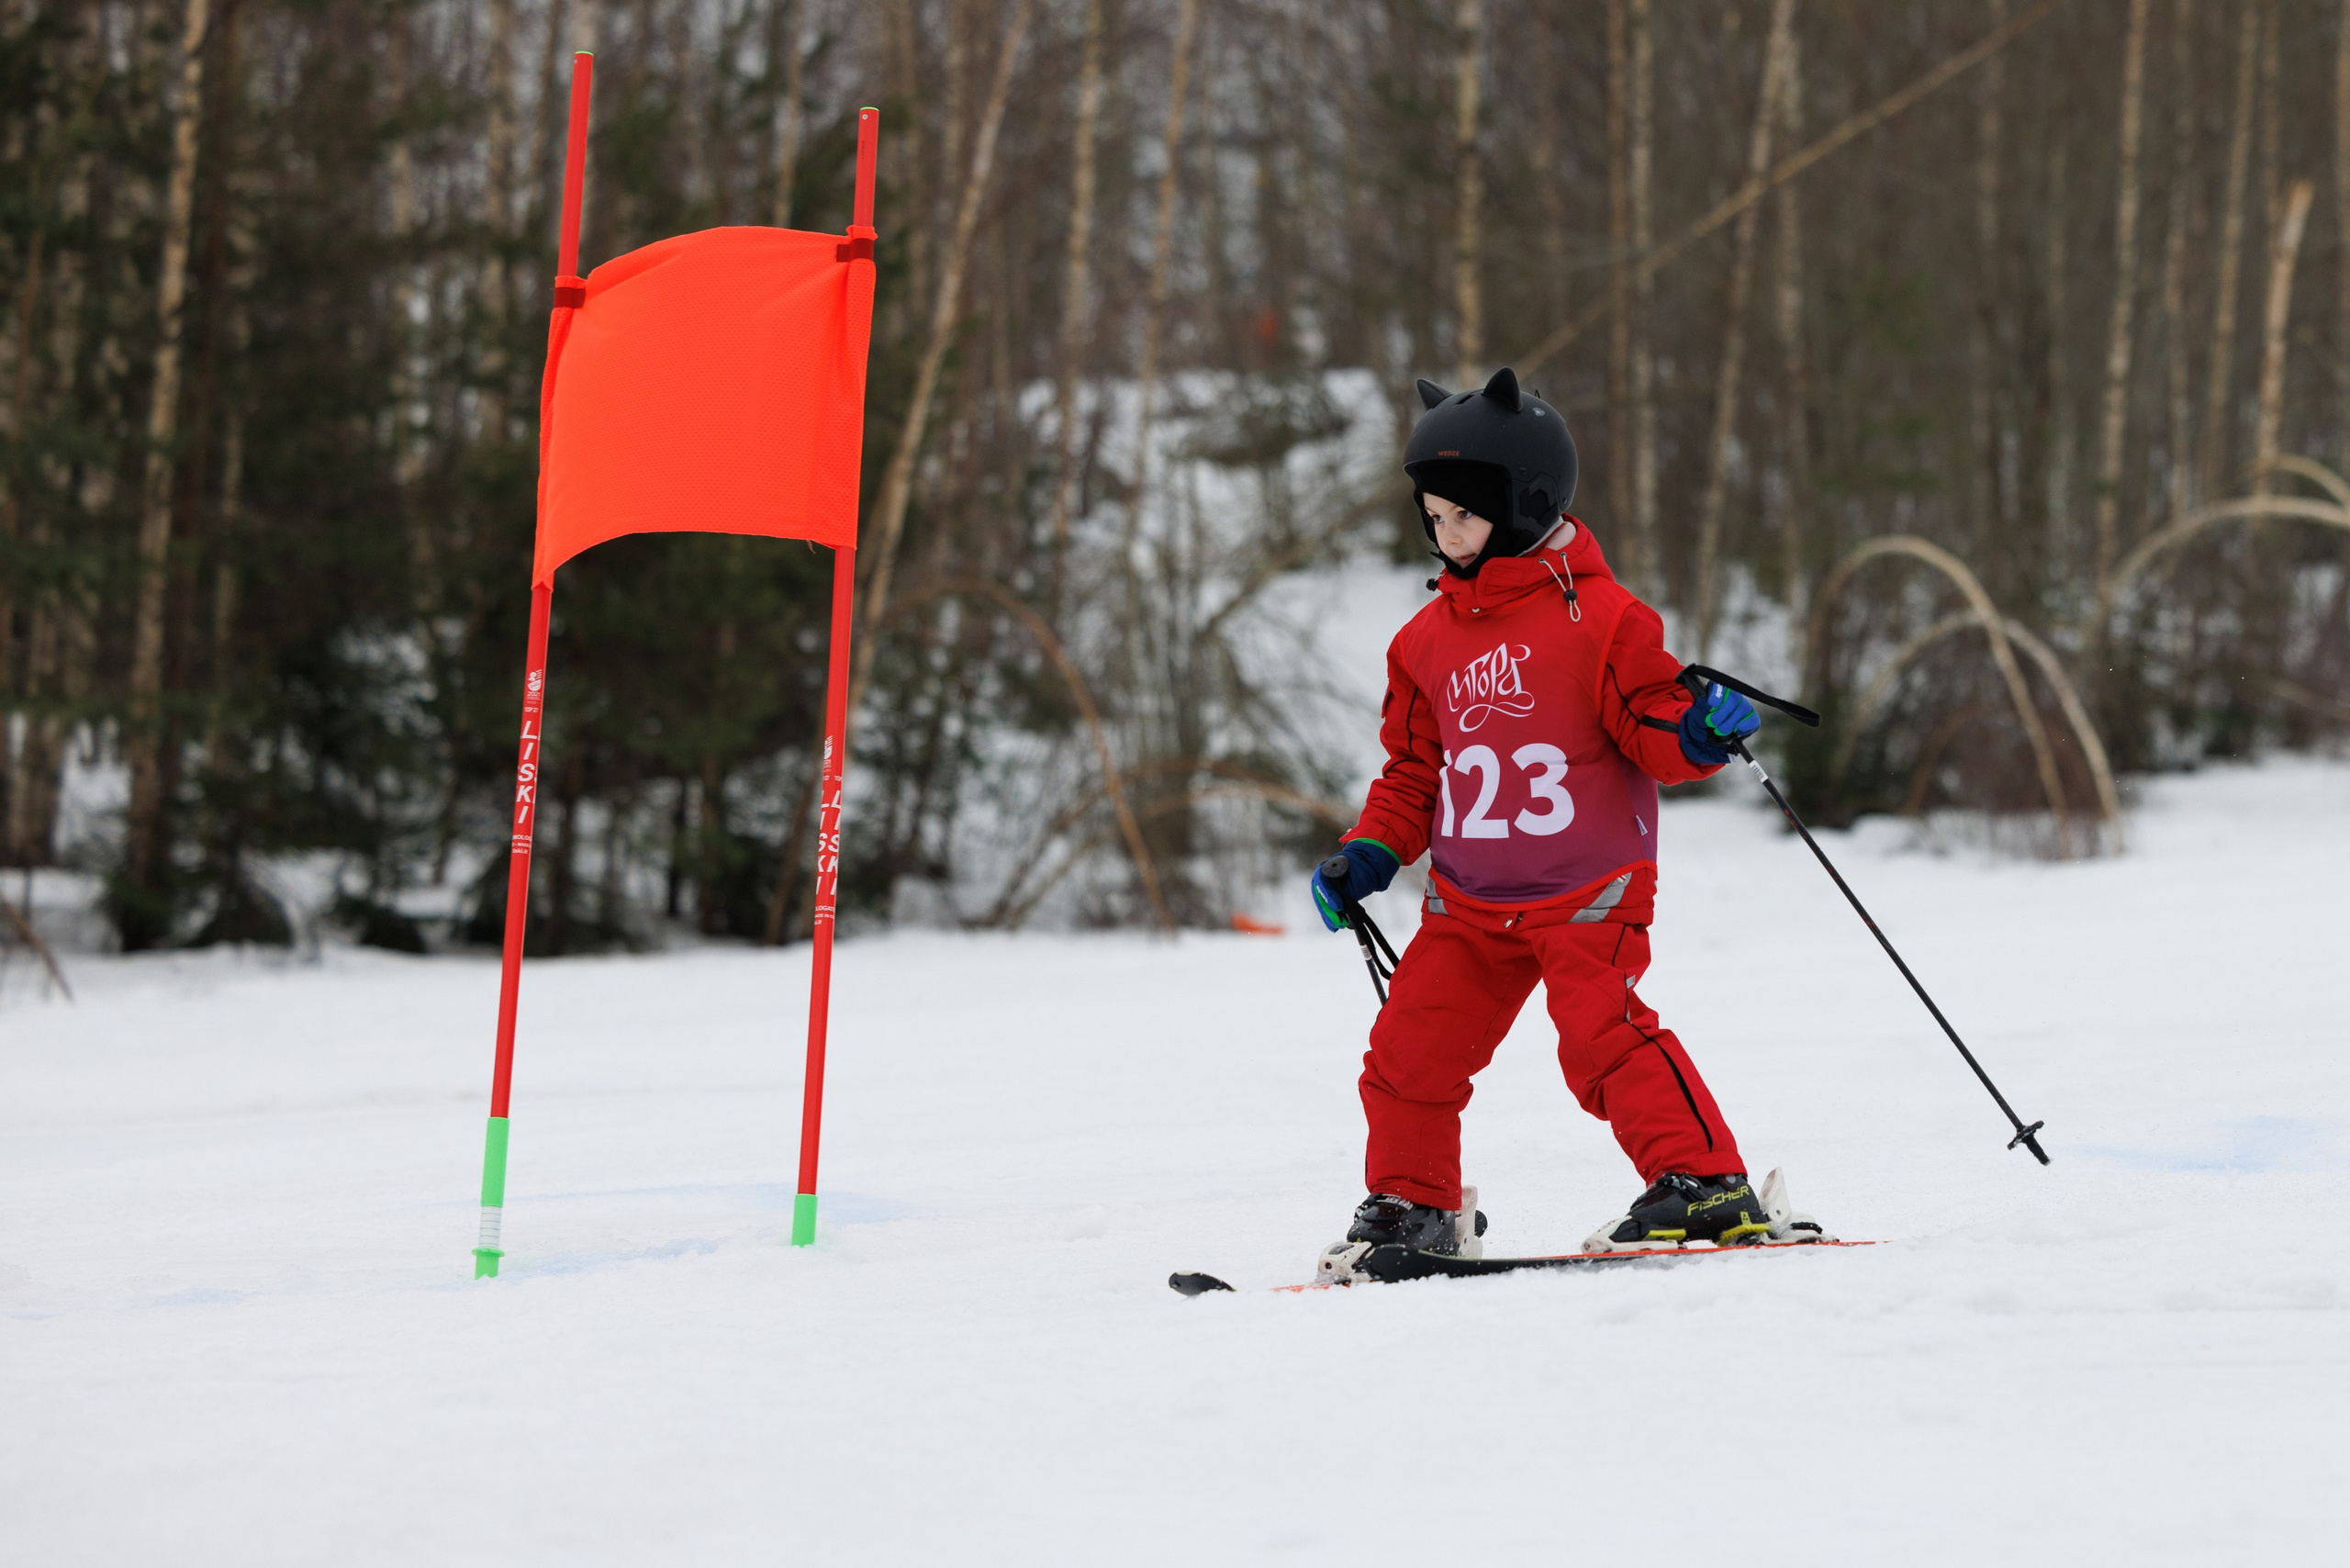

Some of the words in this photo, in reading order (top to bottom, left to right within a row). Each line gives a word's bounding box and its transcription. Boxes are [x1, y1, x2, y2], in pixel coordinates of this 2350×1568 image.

[517, 721, 538, 823] LISKI
[1438, 743, 1575, 839] 123
[1687, 1185, 1750, 1216] FISCHER
